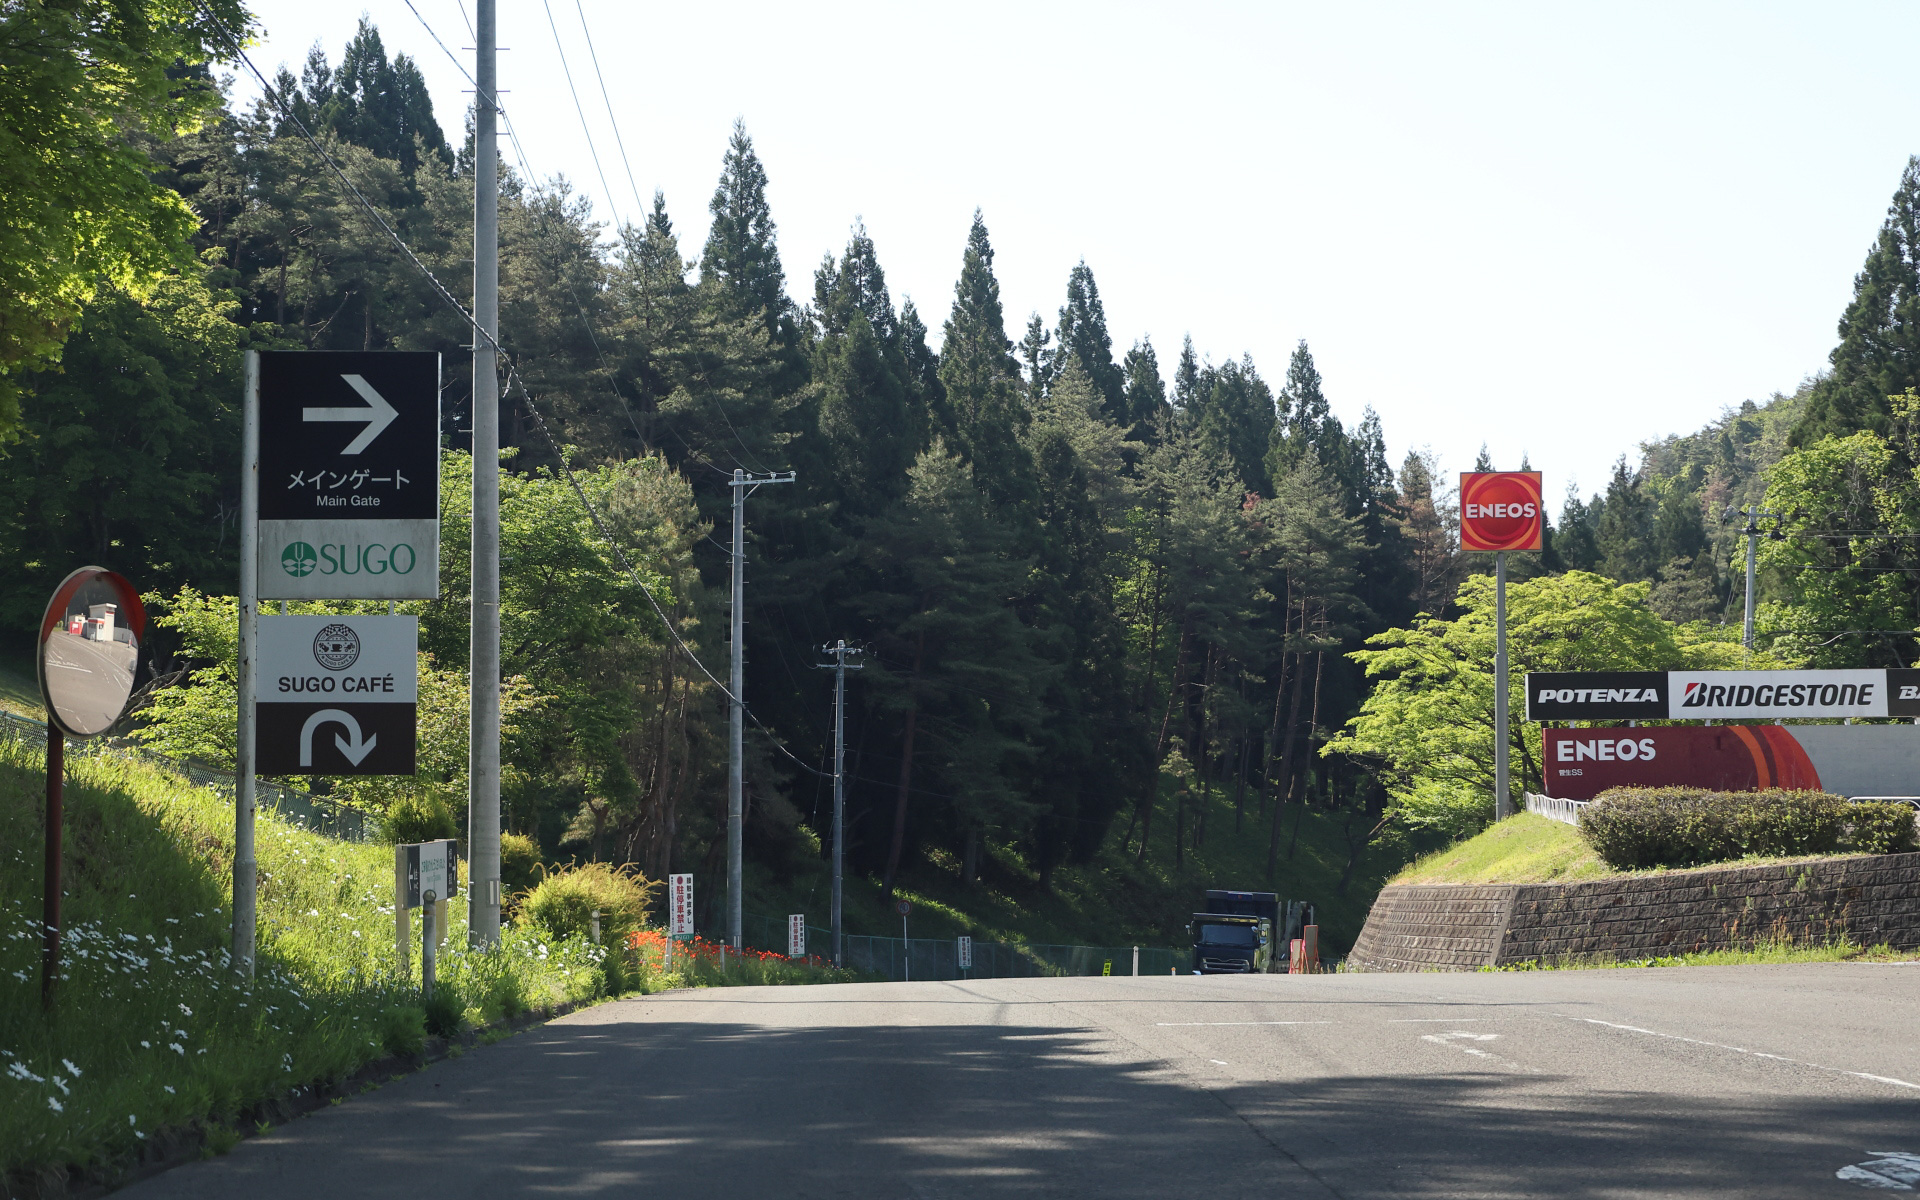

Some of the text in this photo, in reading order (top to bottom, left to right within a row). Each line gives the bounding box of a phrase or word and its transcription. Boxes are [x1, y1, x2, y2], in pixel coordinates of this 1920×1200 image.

[287, 469, 410, 491] メインゲート
[316, 494, 381, 507] Main Gate
[1465, 502, 1536, 519] ENEOS
[319, 543, 416, 575] SUGO
[278, 672, 394, 694] SUGO CAFÉ
[1537, 688, 1659, 704] POTENZA
[1682, 682, 1875, 708] BRIDGESTONE
[1556, 737, 1656, 762] ENEOS
[676, 885, 685, 933] 駐停車禁止
